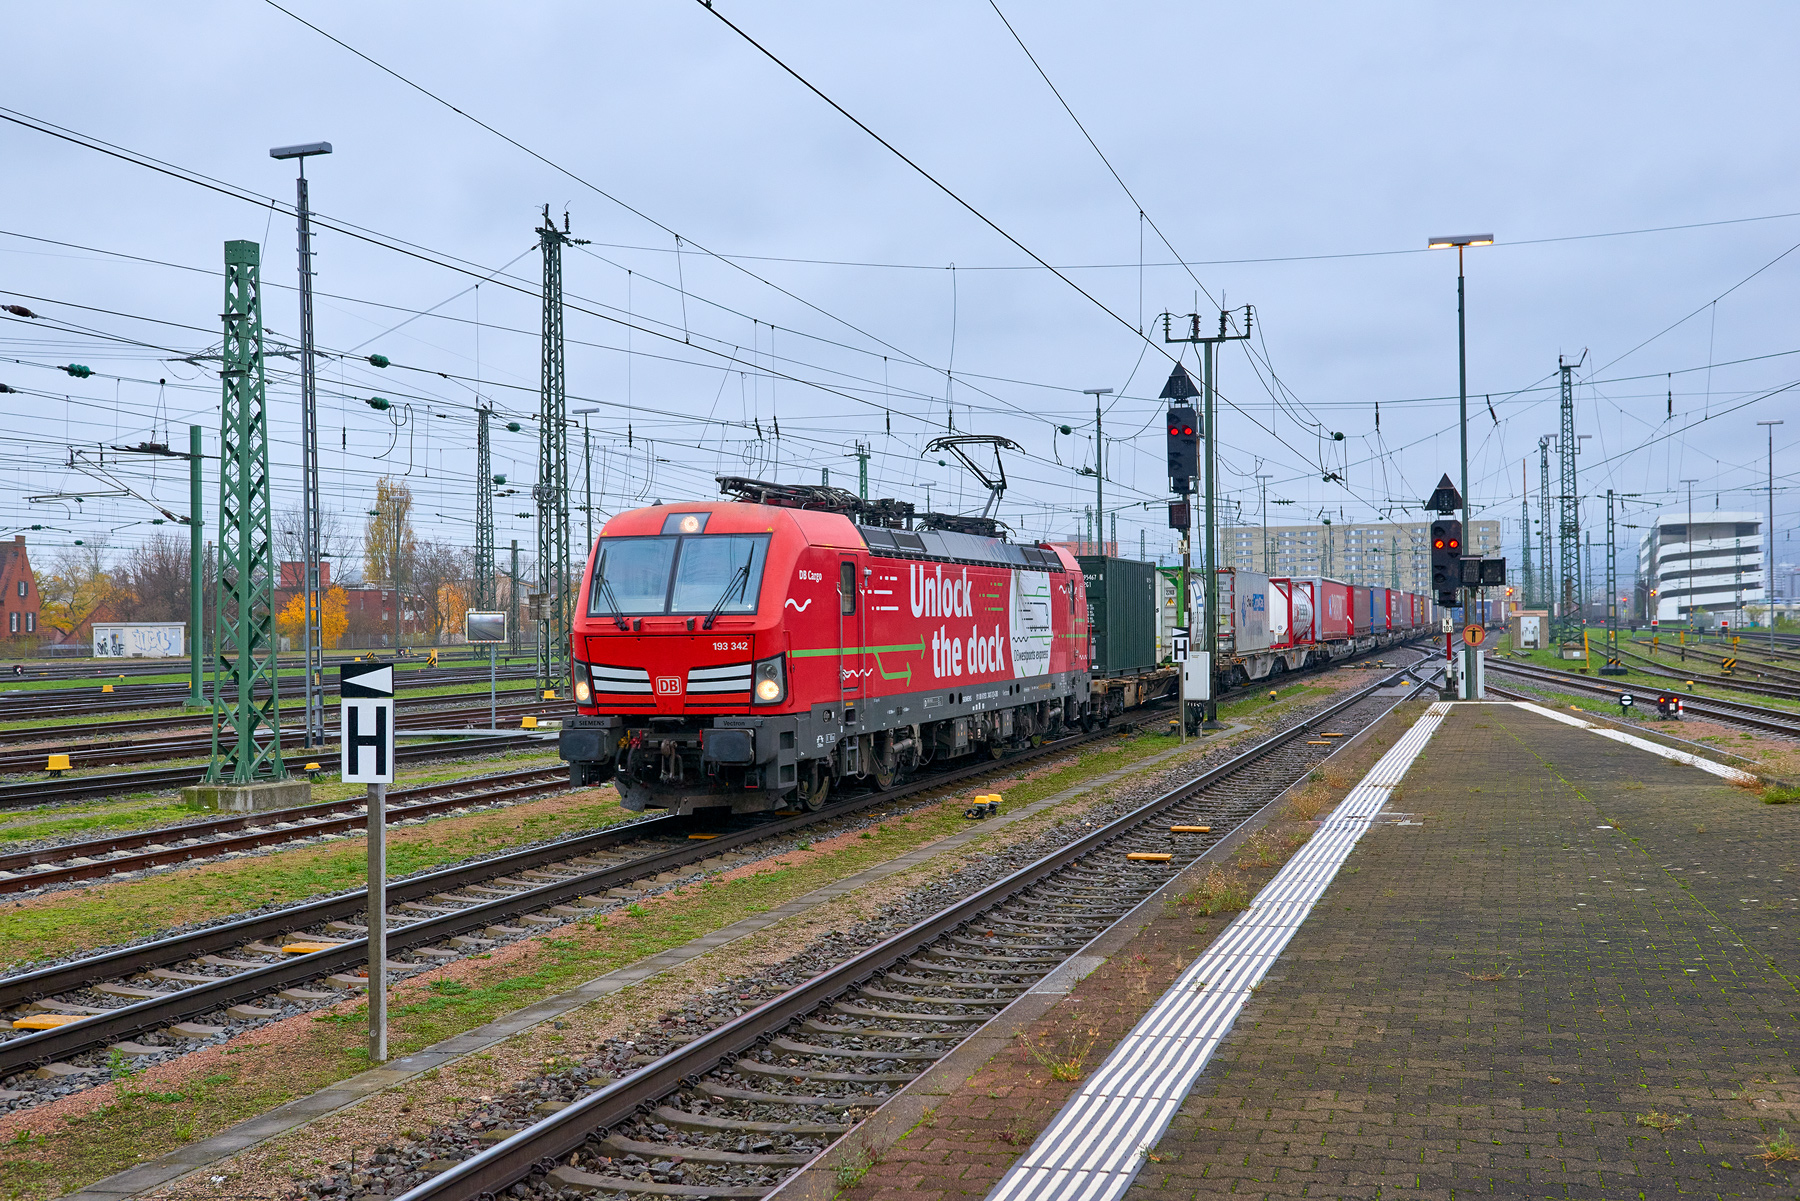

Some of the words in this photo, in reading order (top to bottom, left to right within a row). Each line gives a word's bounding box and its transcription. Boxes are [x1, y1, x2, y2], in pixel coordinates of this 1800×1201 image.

[799, 570, 807, 580] DB
[808, 570, 822, 583] Cargo
[911, 564, 972, 618] Unlock
[712, 642, 728, 651] 193
[730, 642, 748, 650] 342
[932, 624, 962, 678] the
[967, 624, 1005, 675] dock
[1174, 640, 1187, 660] H
[658, 678, 680, 694] DB
[348, 706, 387, 776] H
